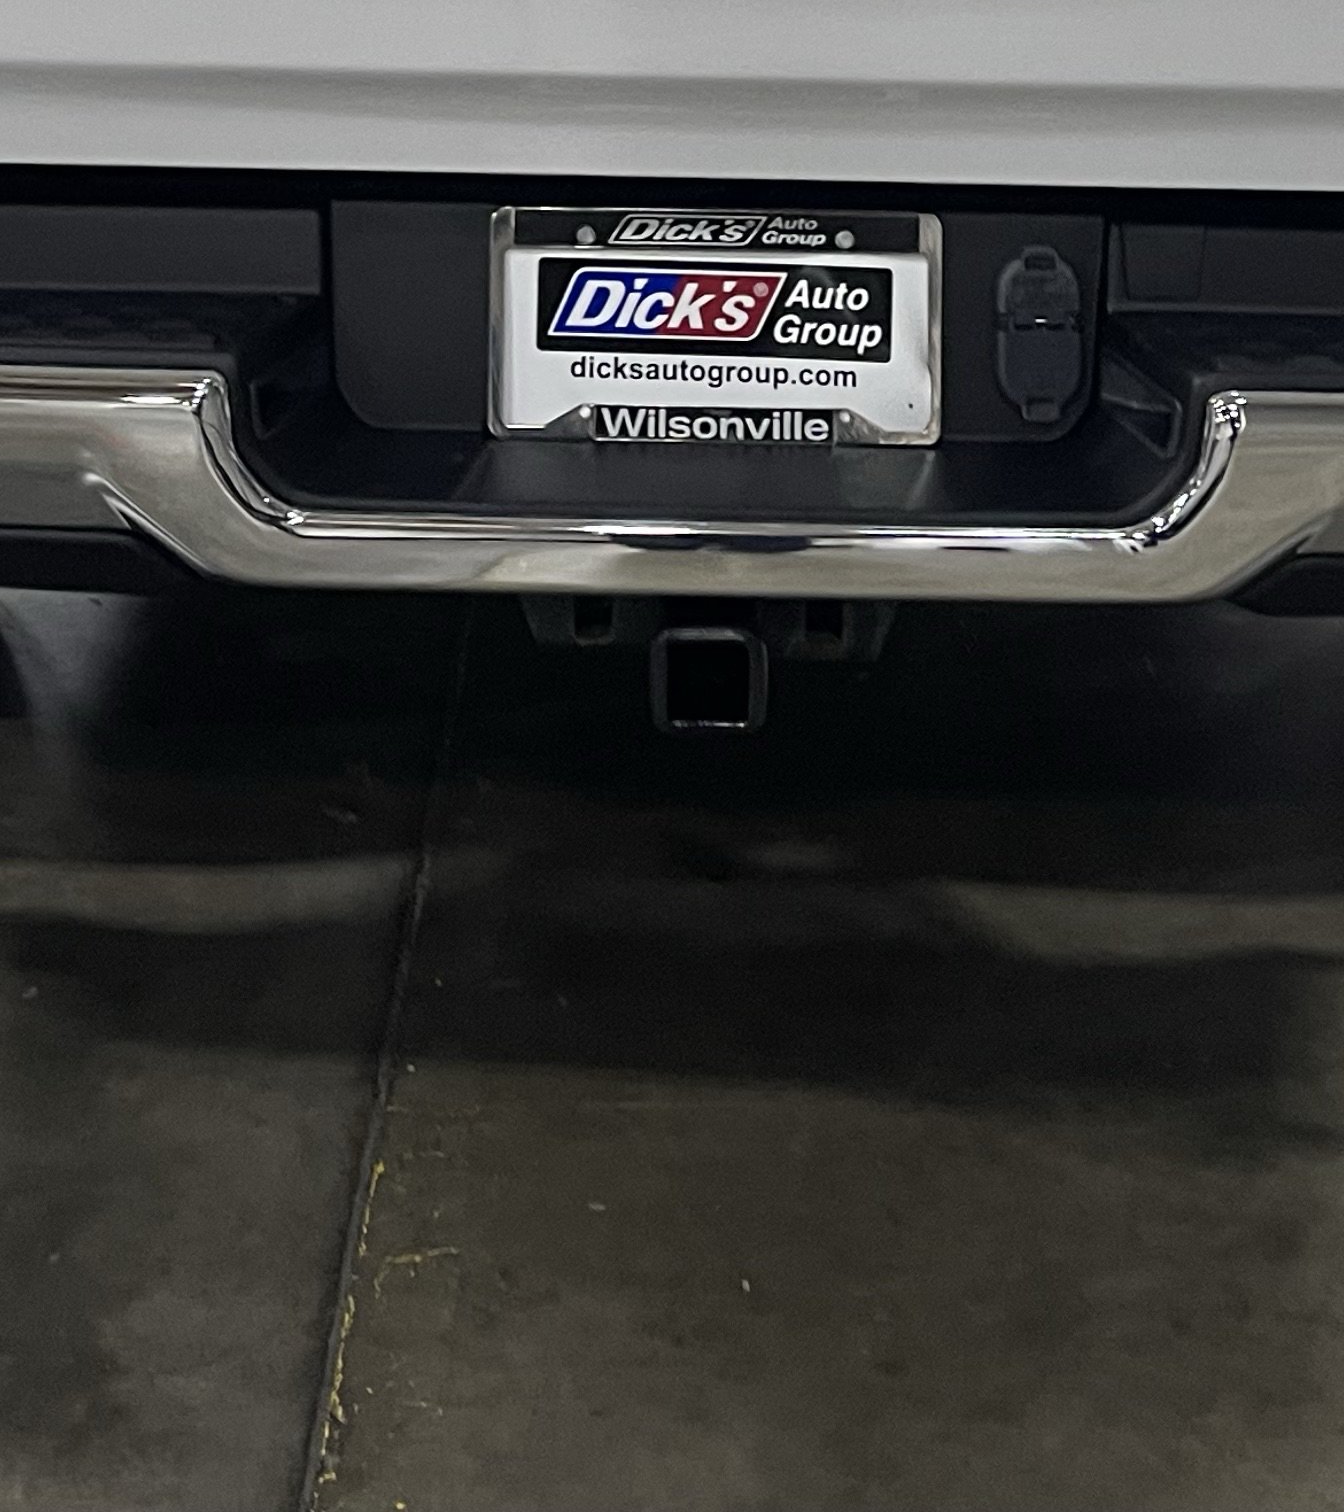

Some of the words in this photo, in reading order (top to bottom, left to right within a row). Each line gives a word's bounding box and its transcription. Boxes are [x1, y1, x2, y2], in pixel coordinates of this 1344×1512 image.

[618, 217, 748, 242] Dick's
[767, 216, 818, 231] Auto
[761, 230, 827, 247] Group
[564, 277, 757, 332] Dick's
[784, 280, 869, 311] Auto
[773, 314, 883, 355] Group
[570, 355, 858, 390] dicksautogroup.com
[601, 406, 830, 442] Wilsonville
